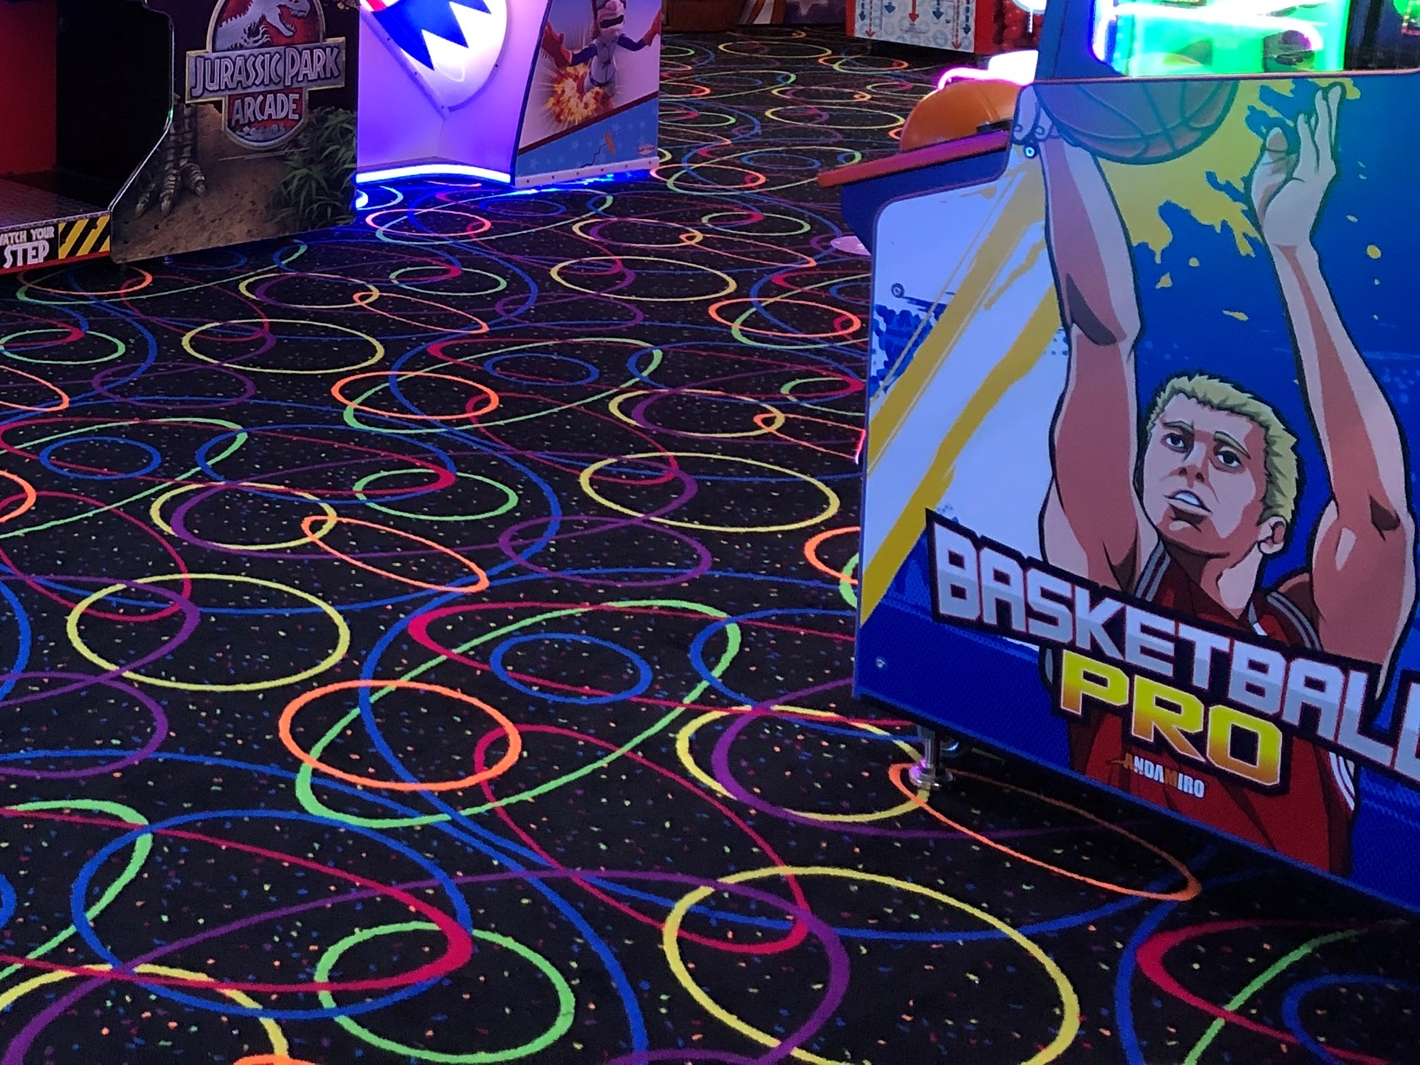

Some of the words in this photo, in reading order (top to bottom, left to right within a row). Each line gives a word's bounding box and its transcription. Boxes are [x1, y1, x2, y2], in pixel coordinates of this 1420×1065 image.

[190, 52, 282, 98] JURASSIC
[283, 46, 341, 86] PARK
[231, 92, 301, 127] ARCADE
[3, 239, 49, 269] STEP
[30, 226, 55, 241] YOUR
[932, 523, 1420, 782] BASKETBALL
[1059, 648, 1283, 787] PRO
[1123, 752, 1205, 799] ANDAMIRO
